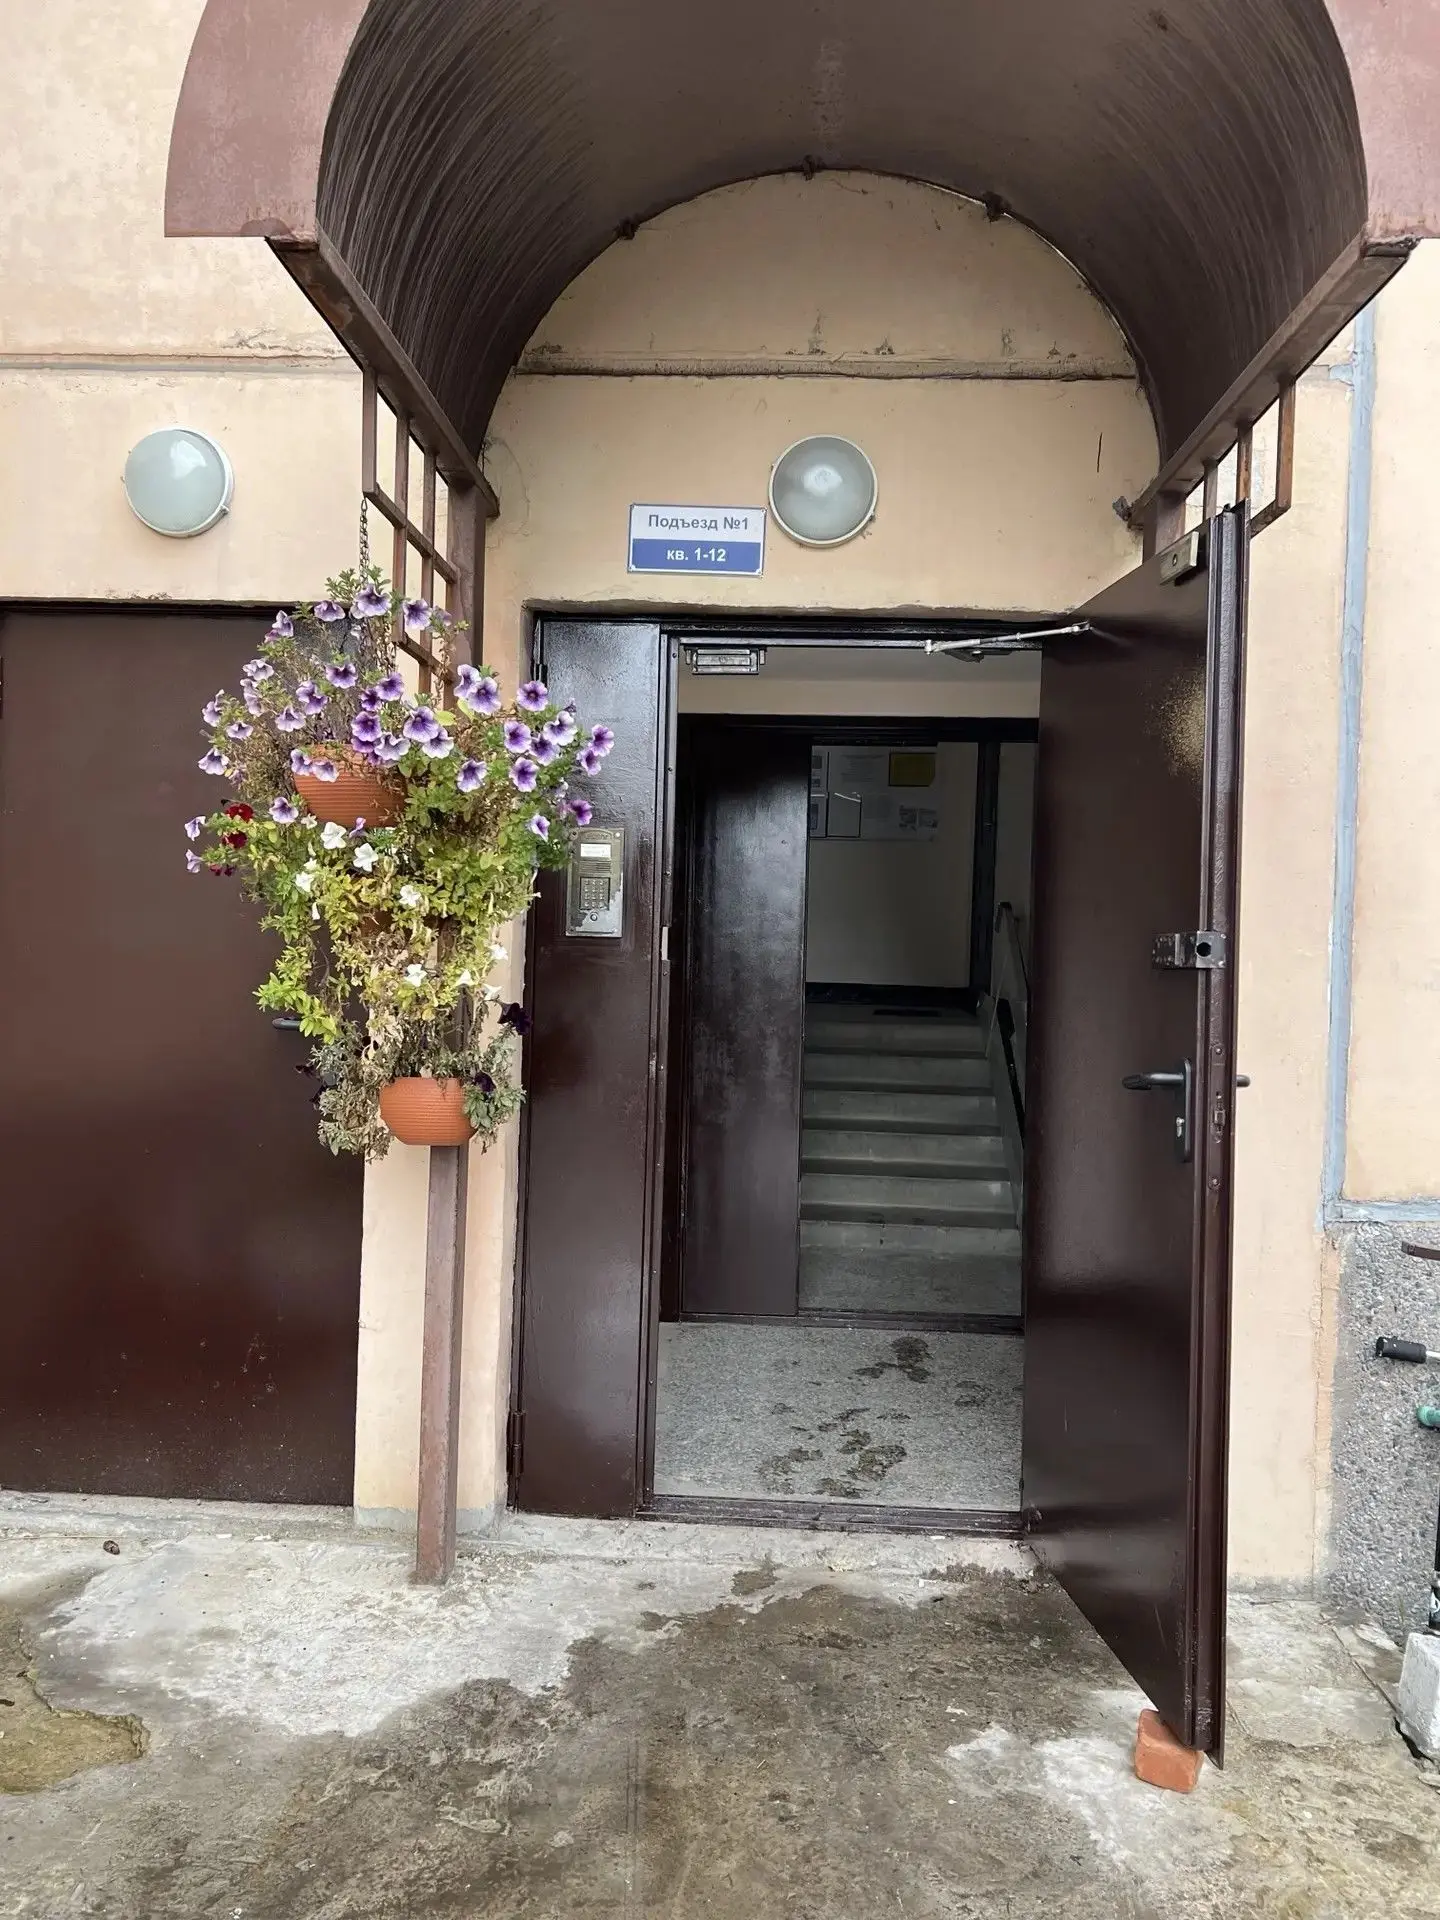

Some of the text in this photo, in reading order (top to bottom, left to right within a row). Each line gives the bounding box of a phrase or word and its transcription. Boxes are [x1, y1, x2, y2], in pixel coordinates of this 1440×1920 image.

[649, 514, 748, 531] Подъезд №1
[666, 548, 726, 562] кв. 1-12
